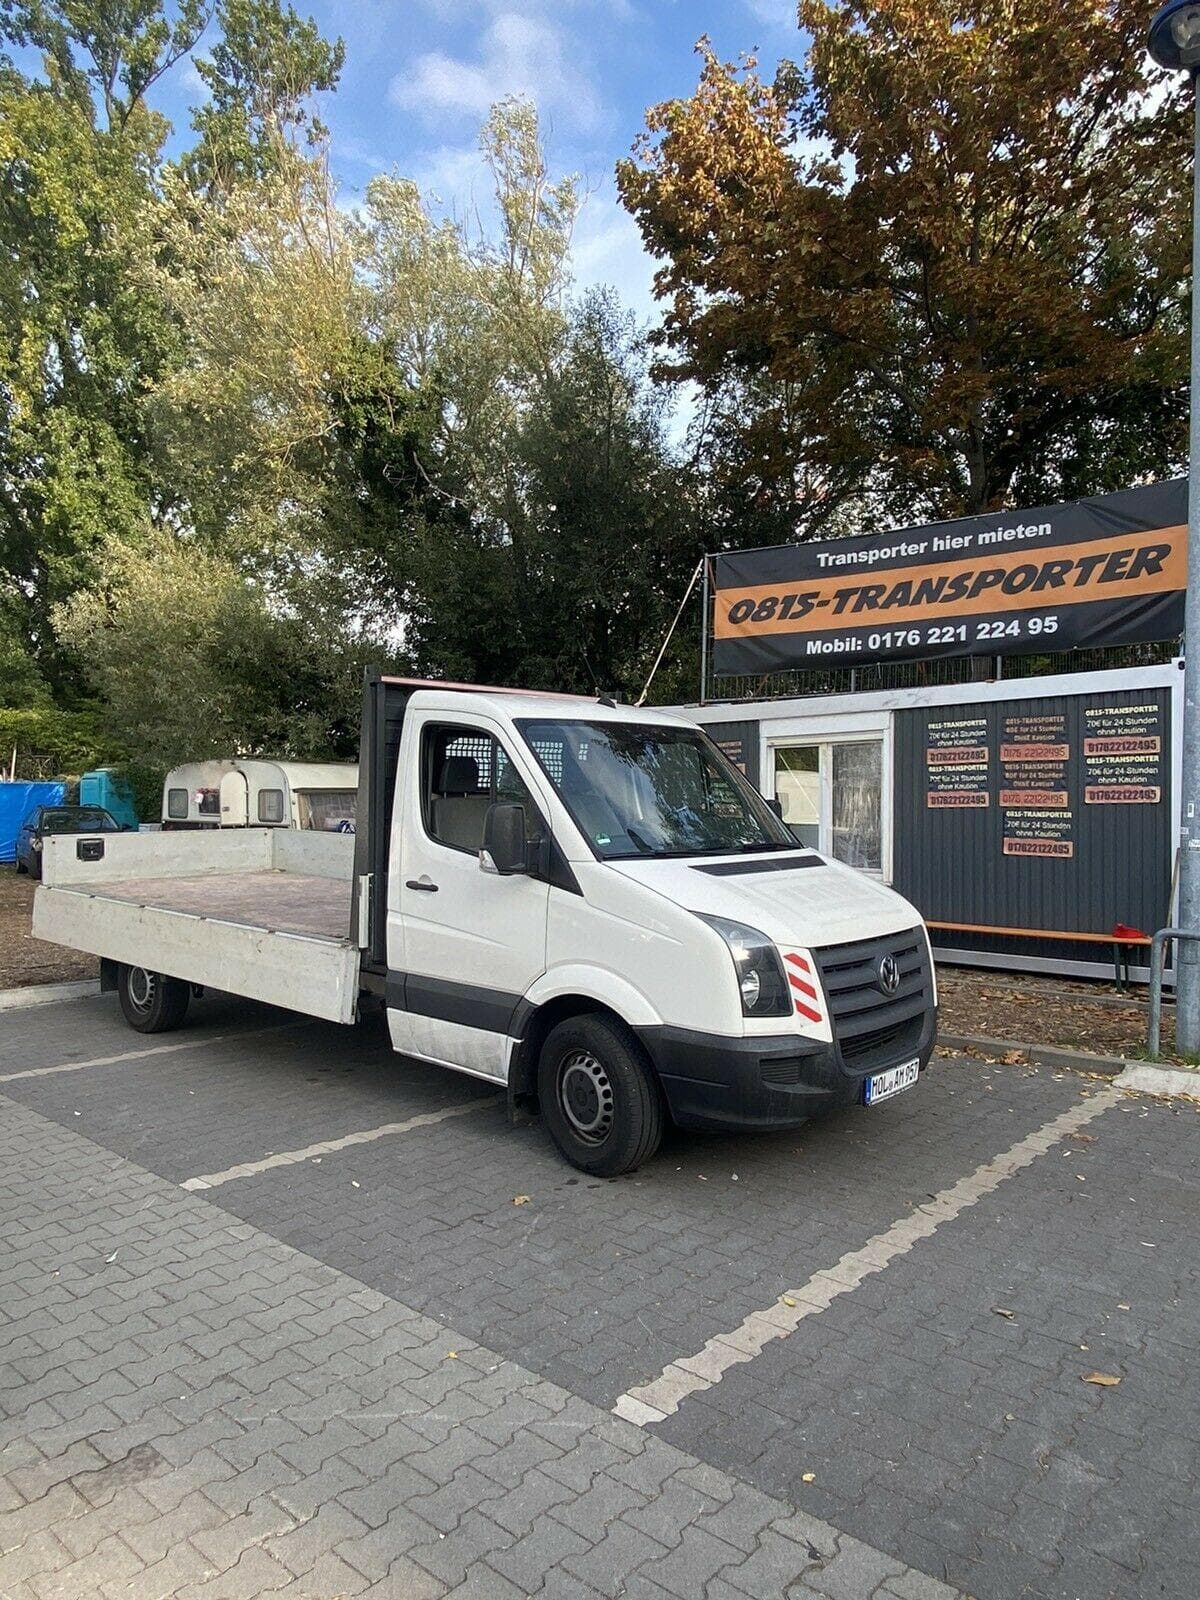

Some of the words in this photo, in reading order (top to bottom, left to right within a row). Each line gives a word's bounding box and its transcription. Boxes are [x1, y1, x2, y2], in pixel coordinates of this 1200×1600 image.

[816, 542, 928, 567] Transporter
[932, 535, 973, 552] hier
[978, 523, 1052, 545] mieten
[727, 543, 1172, 624] 0815-TRANSPORTER
[806, 637, 862, 655] Mobil:
[868, 629, 921, 650] 0176
[927, 624, 967, 644] 221
[976, 620, 1020, 640] 224
[1027, 616, 1058, 635] 95
[960, 730, 987, 738] Stunden
[1126, 717, 1158, 726] Stunden
